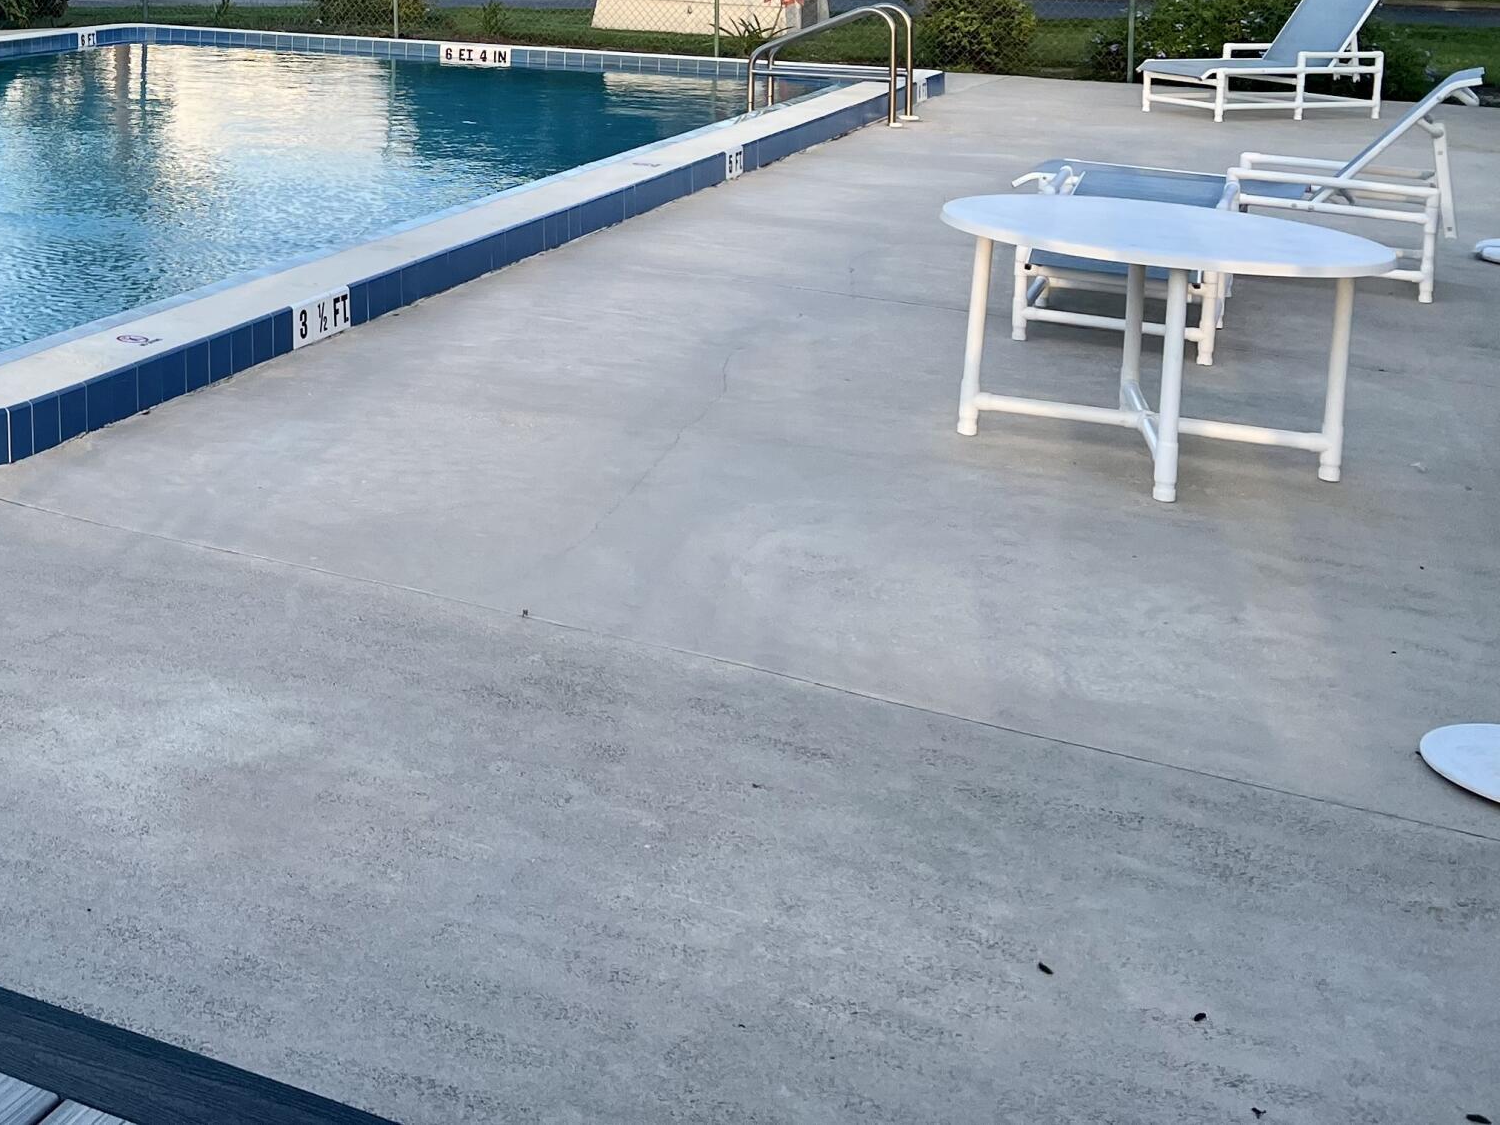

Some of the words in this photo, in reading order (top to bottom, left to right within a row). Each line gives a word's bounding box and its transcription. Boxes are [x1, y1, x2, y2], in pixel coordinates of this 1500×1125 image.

[445, 48, 453, 60] 6
[480, 50, 488, 62] 4
[493, 50, 507, 63] IN
[728, 154, 733, 174] 5
[299, 309, 308, 340] 3
